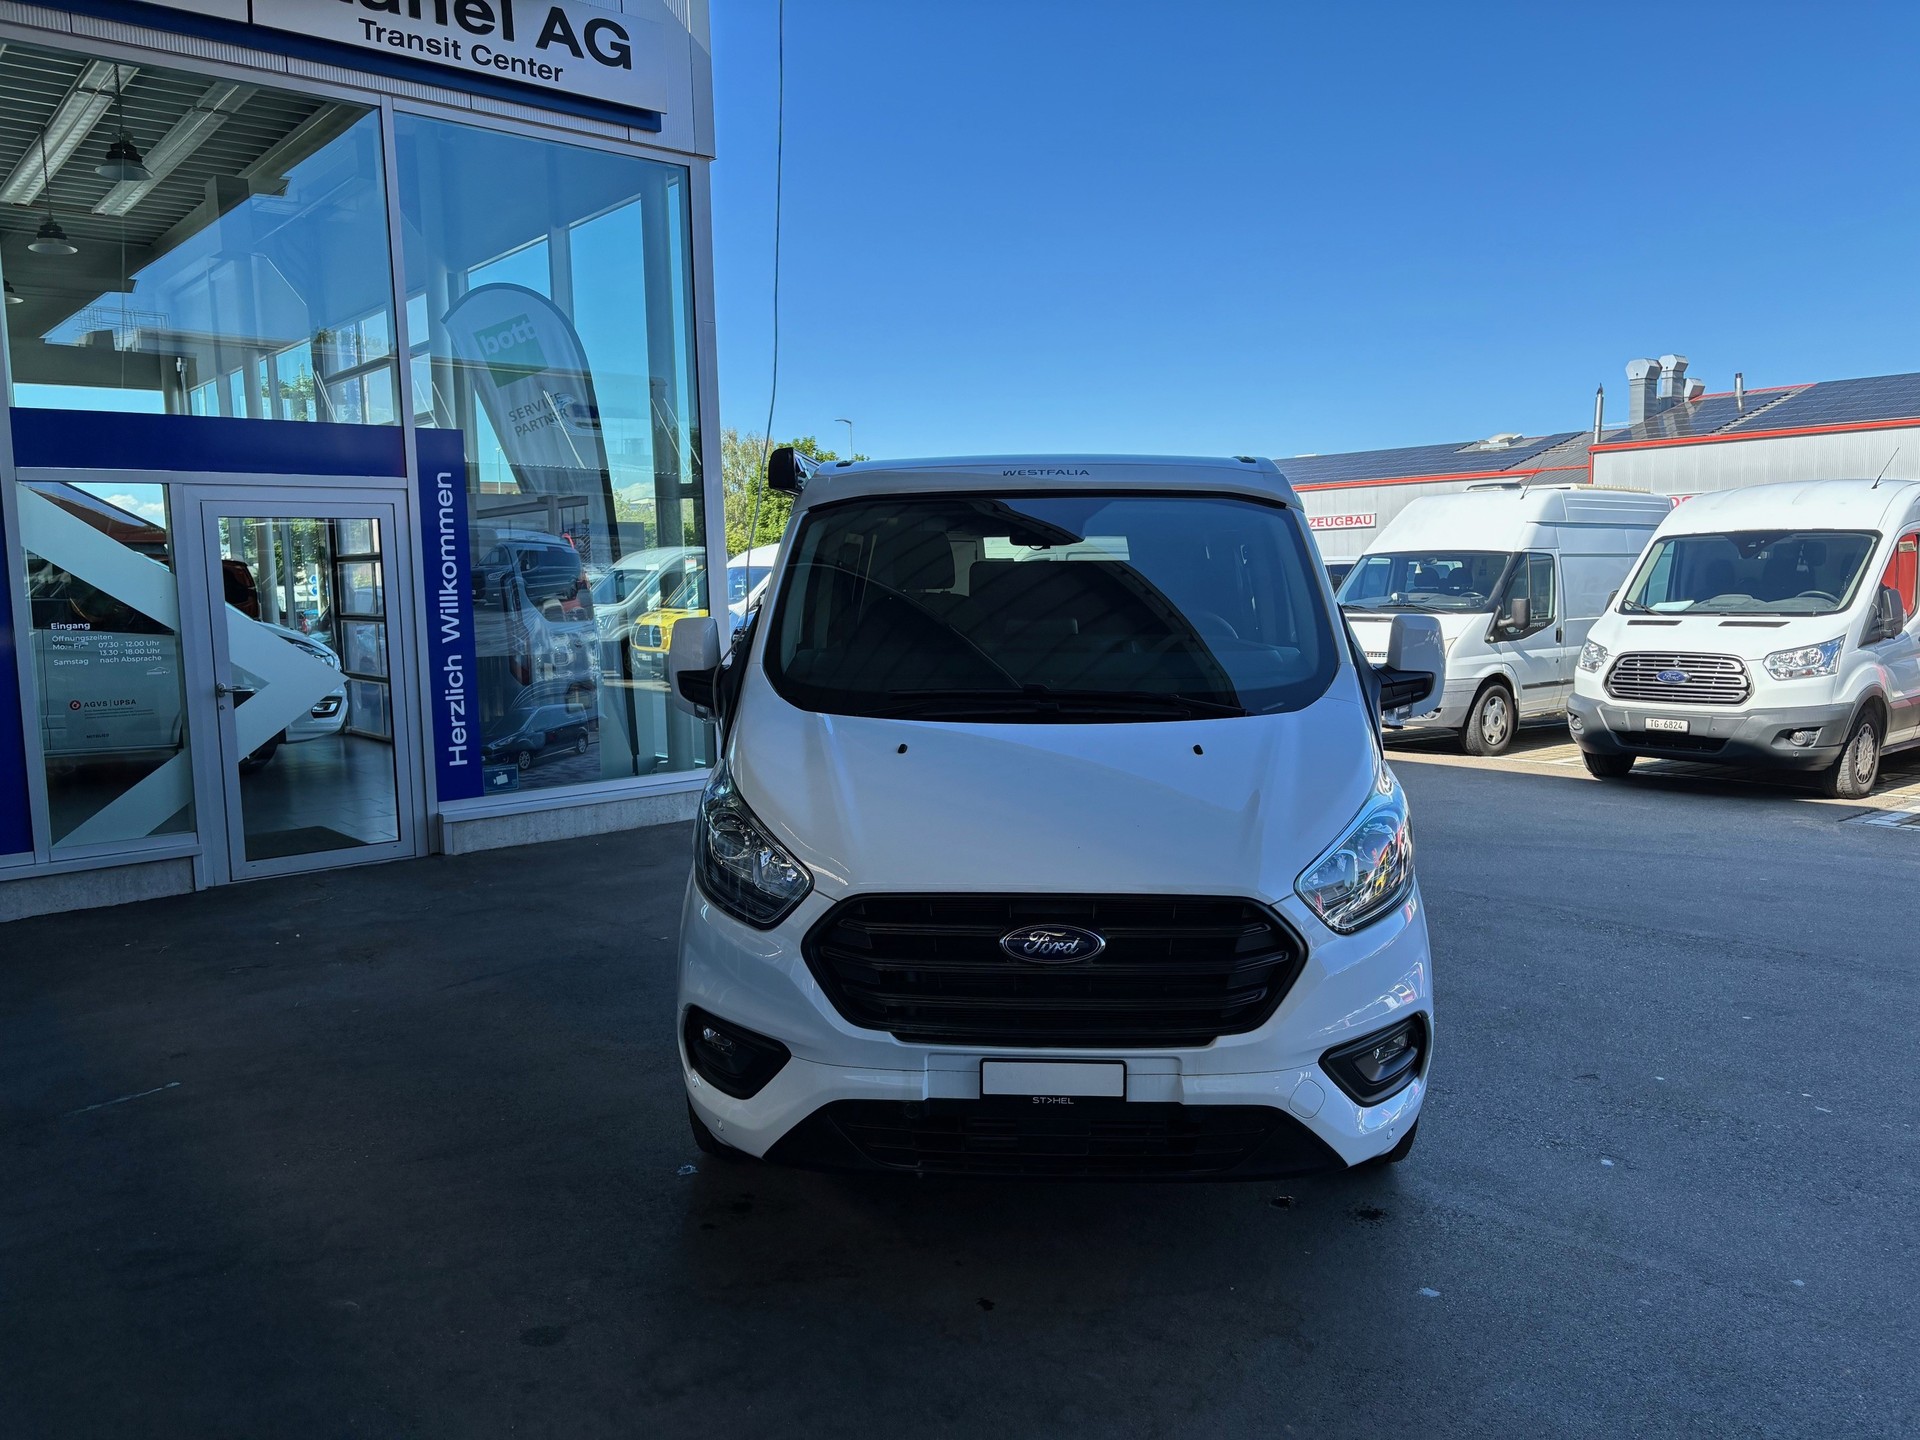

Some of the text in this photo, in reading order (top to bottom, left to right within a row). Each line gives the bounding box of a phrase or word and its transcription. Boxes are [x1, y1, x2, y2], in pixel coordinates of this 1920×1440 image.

[535, 6, 632, 71] AG
[358, 17, 462, 61] Transit
[470, 44, 564, 82] Center
[479, 319, 537, 356] bott
[1002, 469, 1090, 477] WESTFALIA
[437, 471, 468, 767] Herzlich Willkommen
[50, 622, 91, 631] Eingang
[52, 634, 113, 643] Öffnungszeiten
[98, 641, 119, 649] 07.30
[125, 640, 145, 648] 12.00
[145, 639, 160, 647] Uhr
[125, 648, 145, 656] 18.00
[146, 647, 161, 655] Uhr
[53, 658, 89, 667] Samstag
[121, 655, 162, 663] Absprache
[83, 700, 108, 708] AGVS
[1024, 931, 1080, 955] Ford
